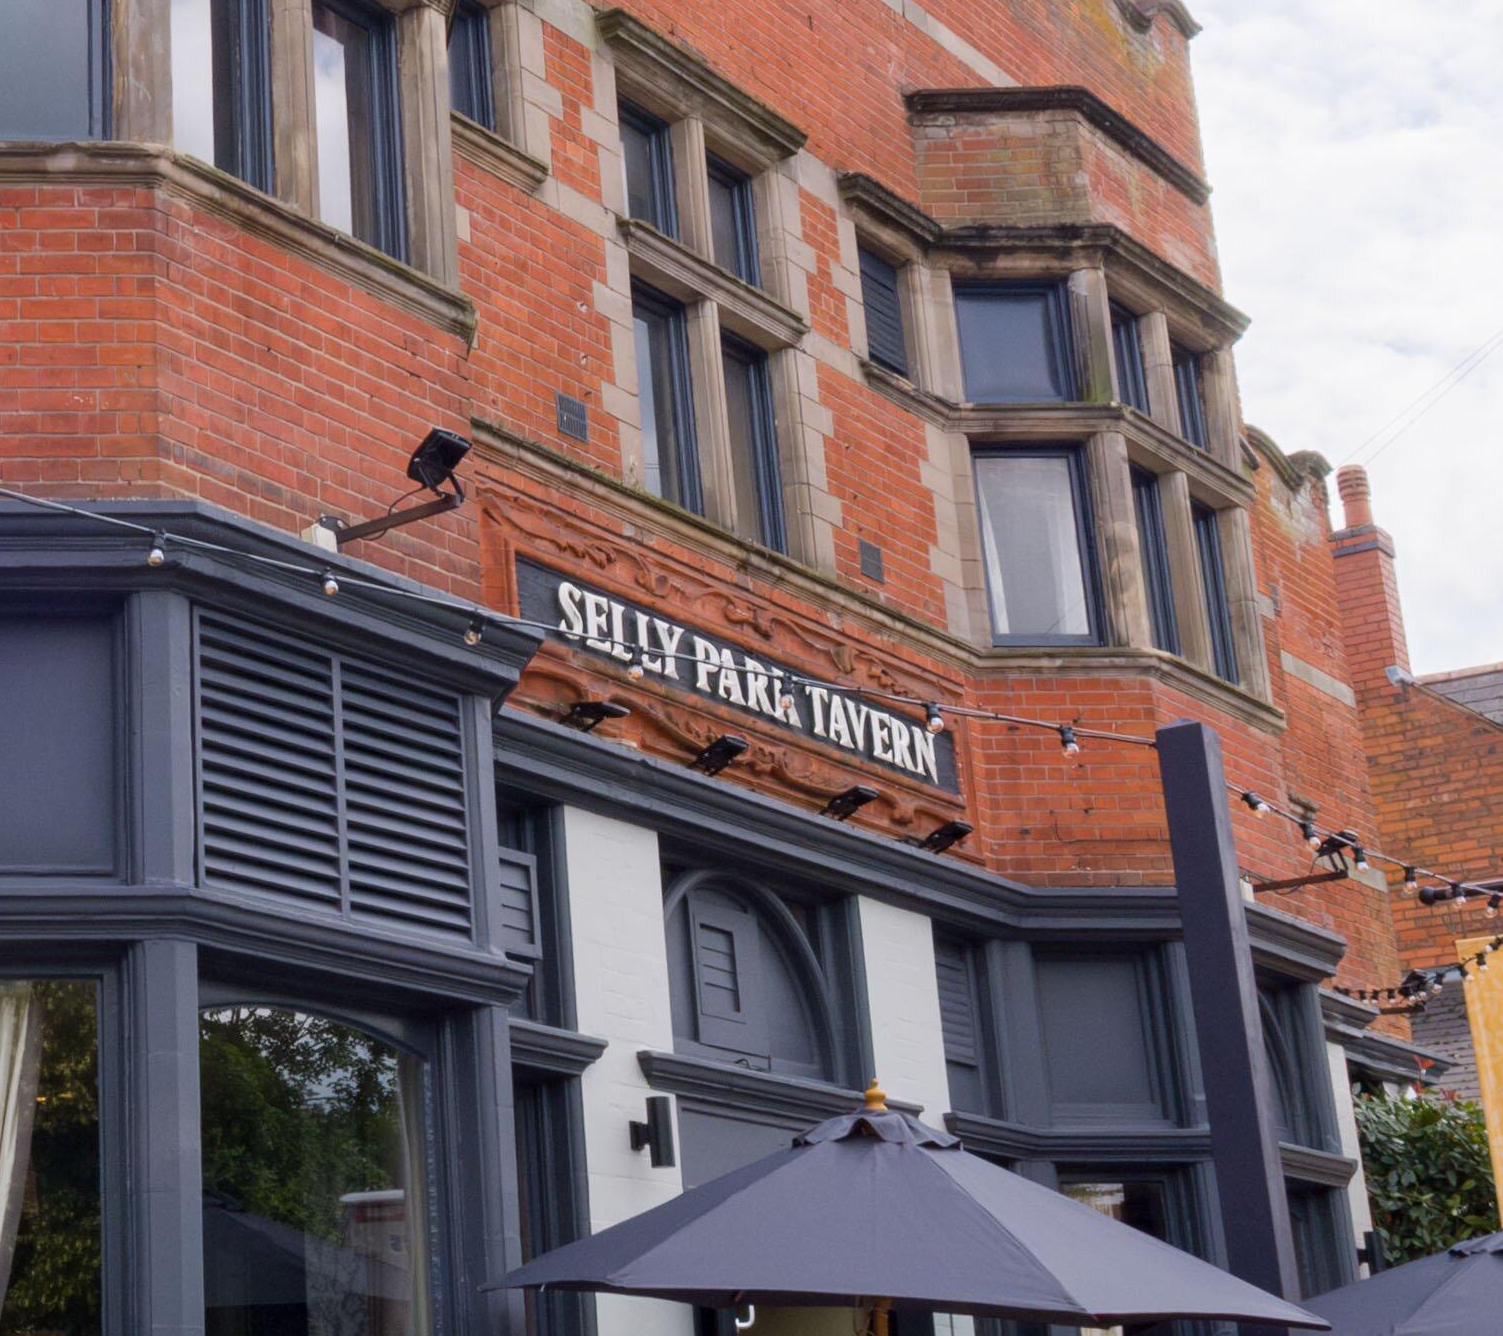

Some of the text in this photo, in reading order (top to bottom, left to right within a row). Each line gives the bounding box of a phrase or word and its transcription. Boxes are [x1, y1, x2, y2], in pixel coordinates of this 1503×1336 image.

[558, 581, 938, 784] SELLY PARK TAVERN
